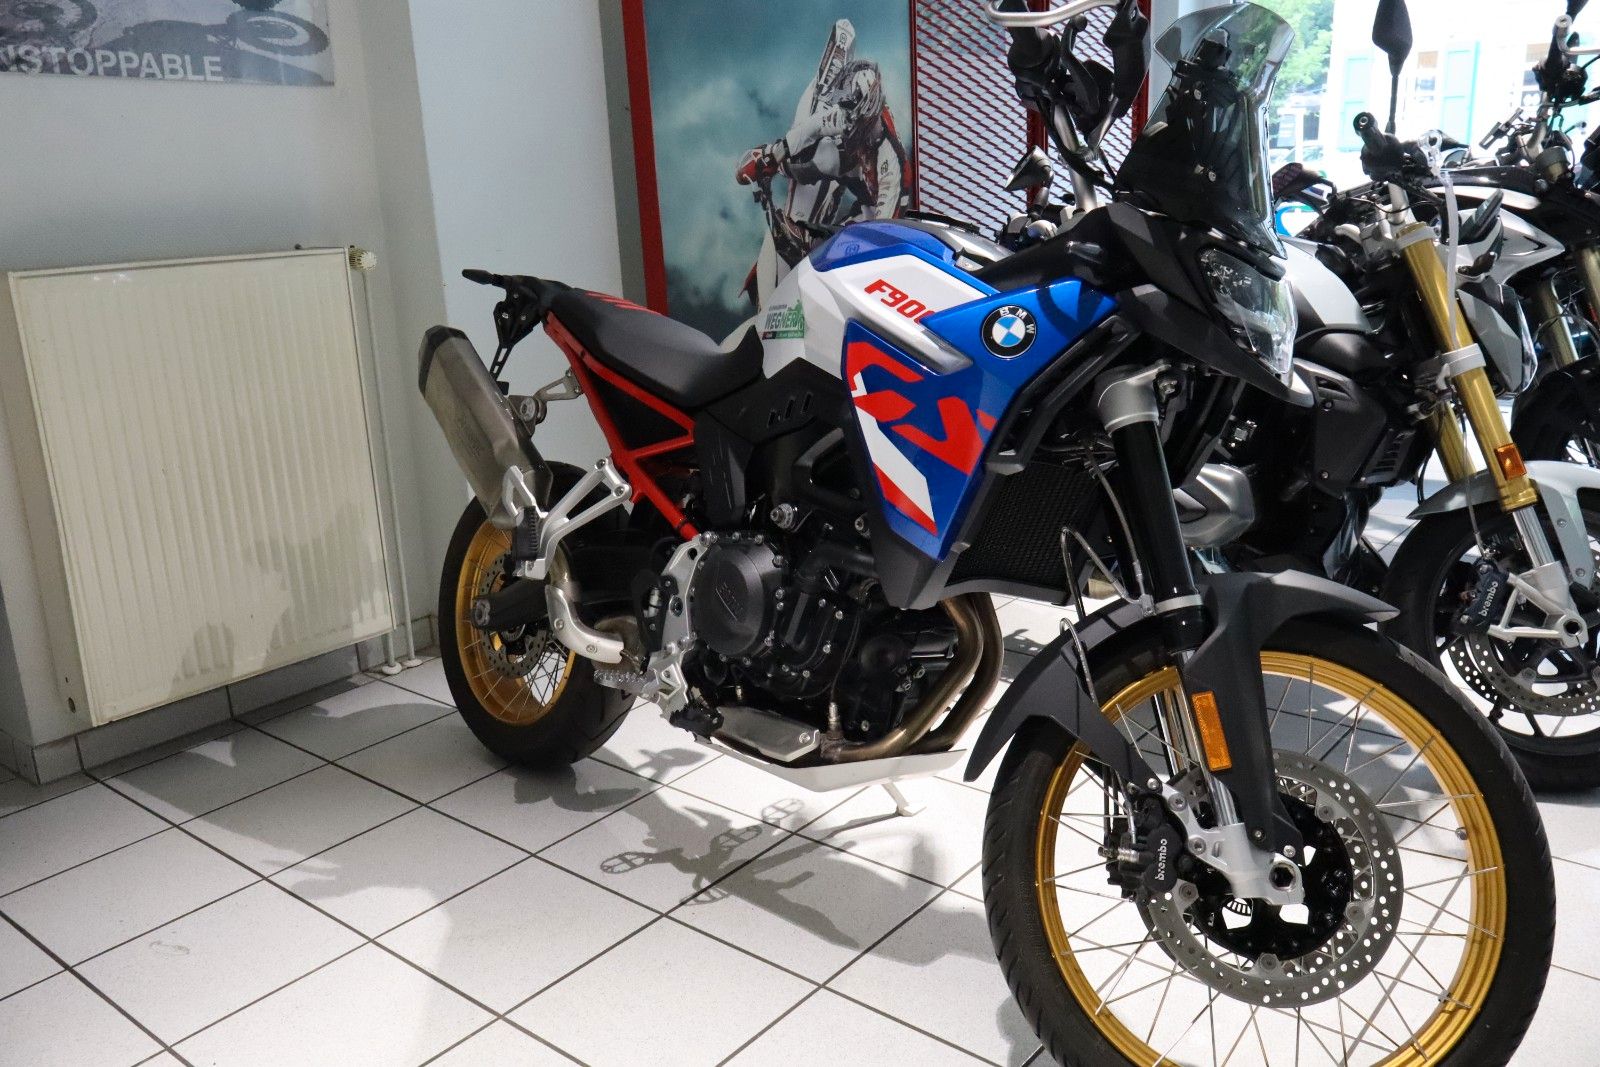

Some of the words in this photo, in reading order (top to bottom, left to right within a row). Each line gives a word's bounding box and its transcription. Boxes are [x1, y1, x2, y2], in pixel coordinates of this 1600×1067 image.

[999, 306, 1035, 334] BMW
[1477, 580, 1499, 617] brembo
[1154, 838, 1168, 881] brembo
